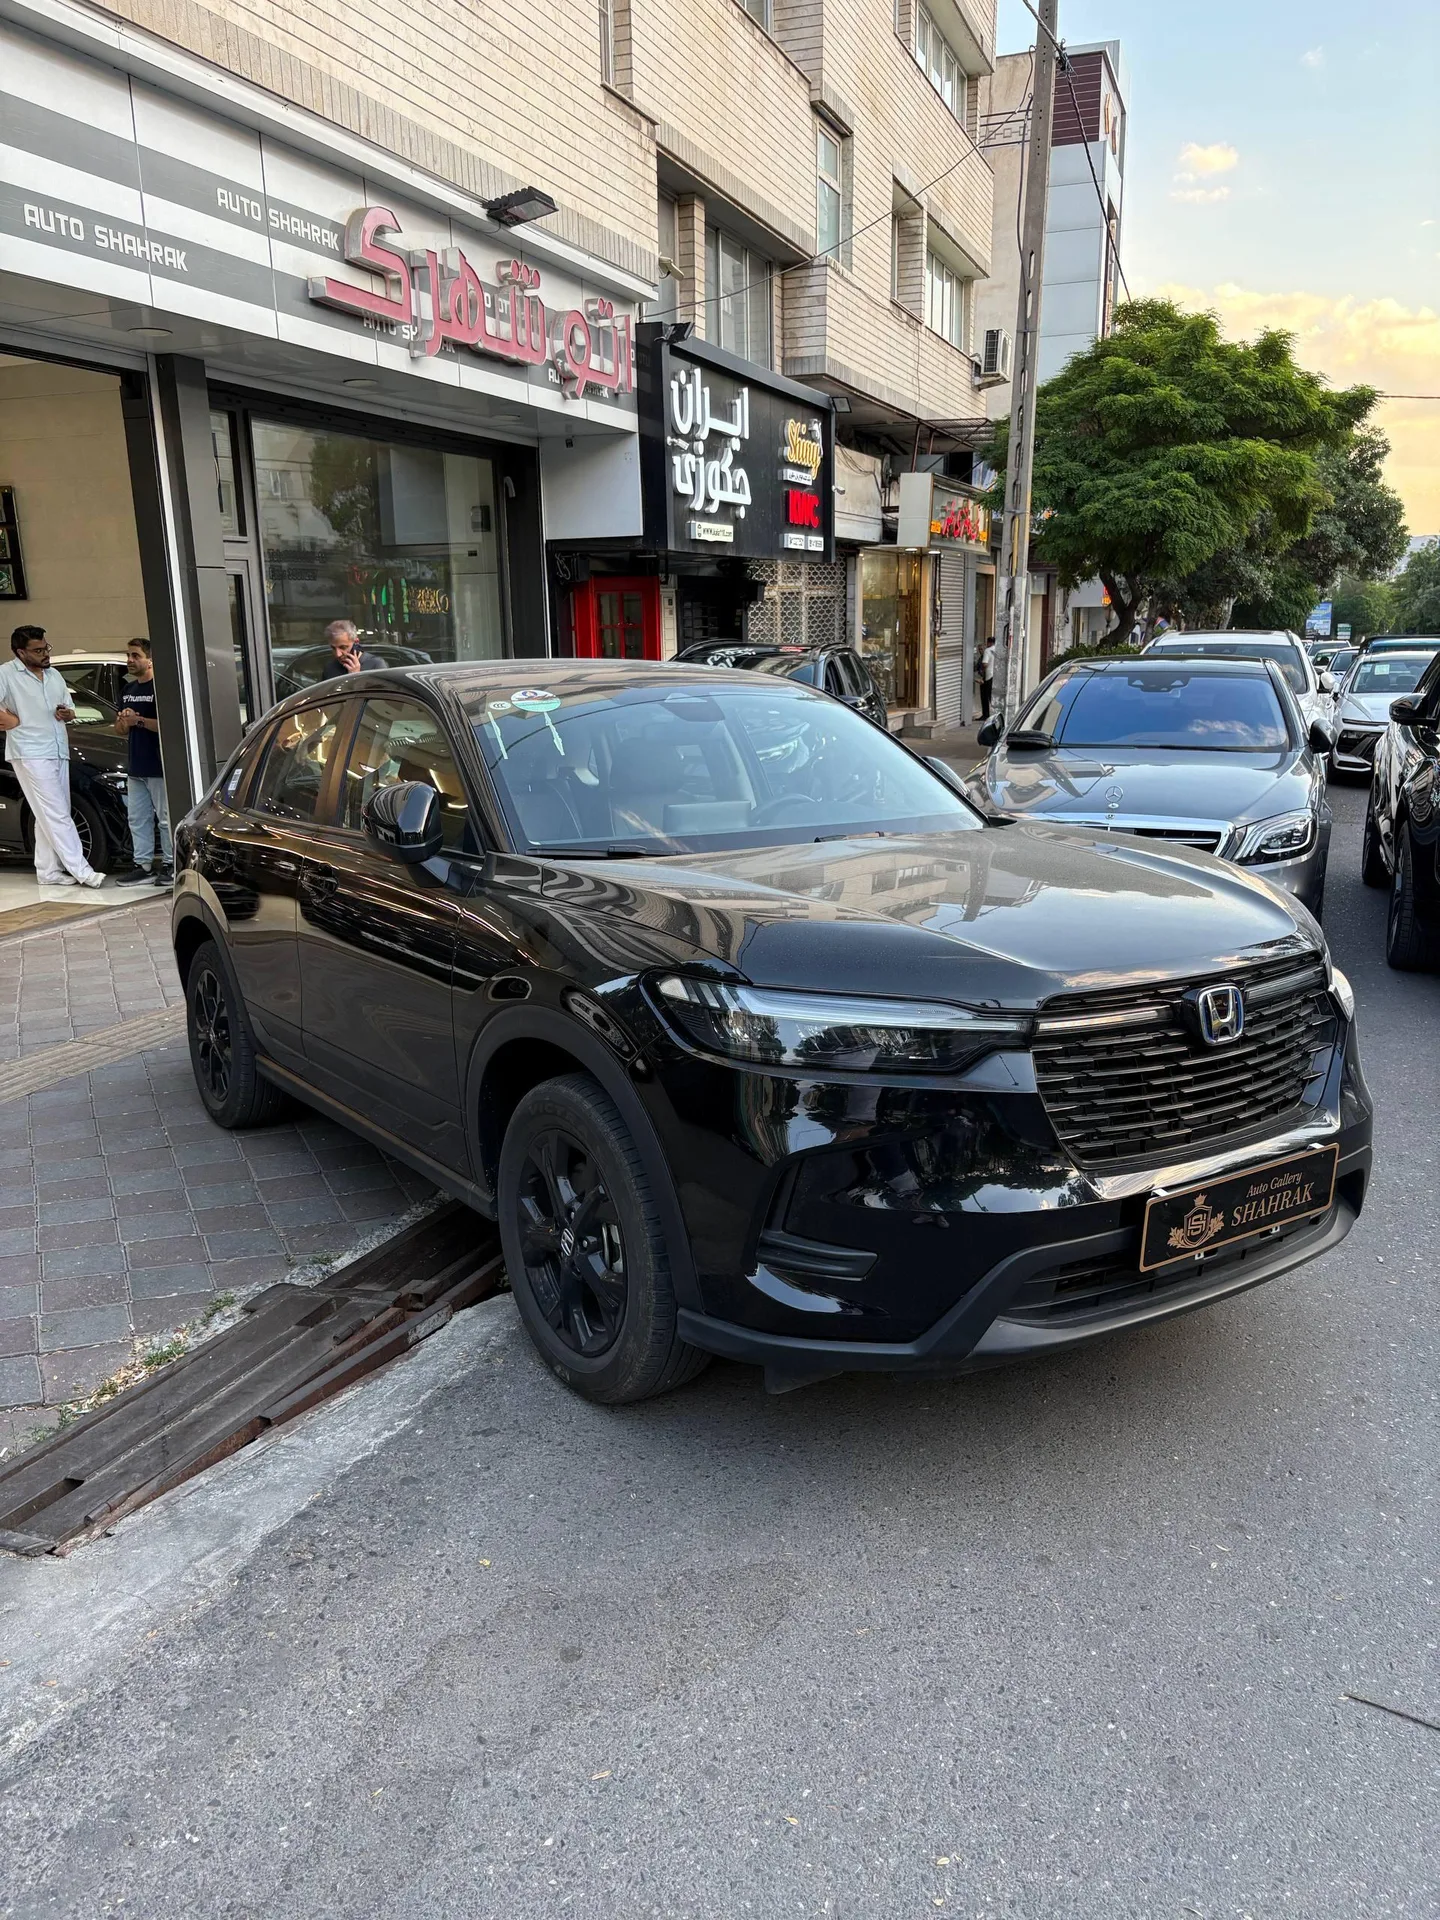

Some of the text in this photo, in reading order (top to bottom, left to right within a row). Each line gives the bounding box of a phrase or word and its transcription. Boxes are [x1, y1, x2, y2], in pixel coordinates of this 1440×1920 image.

[23, 203, 189, 272] AUTO SHAHRAK
[216, 187, 340, 252] AUTO SHAHRAK
[551, 297, 633, 401] اتو
[670, 368, 750, 451] ایران
[785, 418, 822, 480] Shiny
[1231, 1182, 1315, 1227] SHAHRAK
[1246, 1170, 1303, 1199] Auto Gallery
